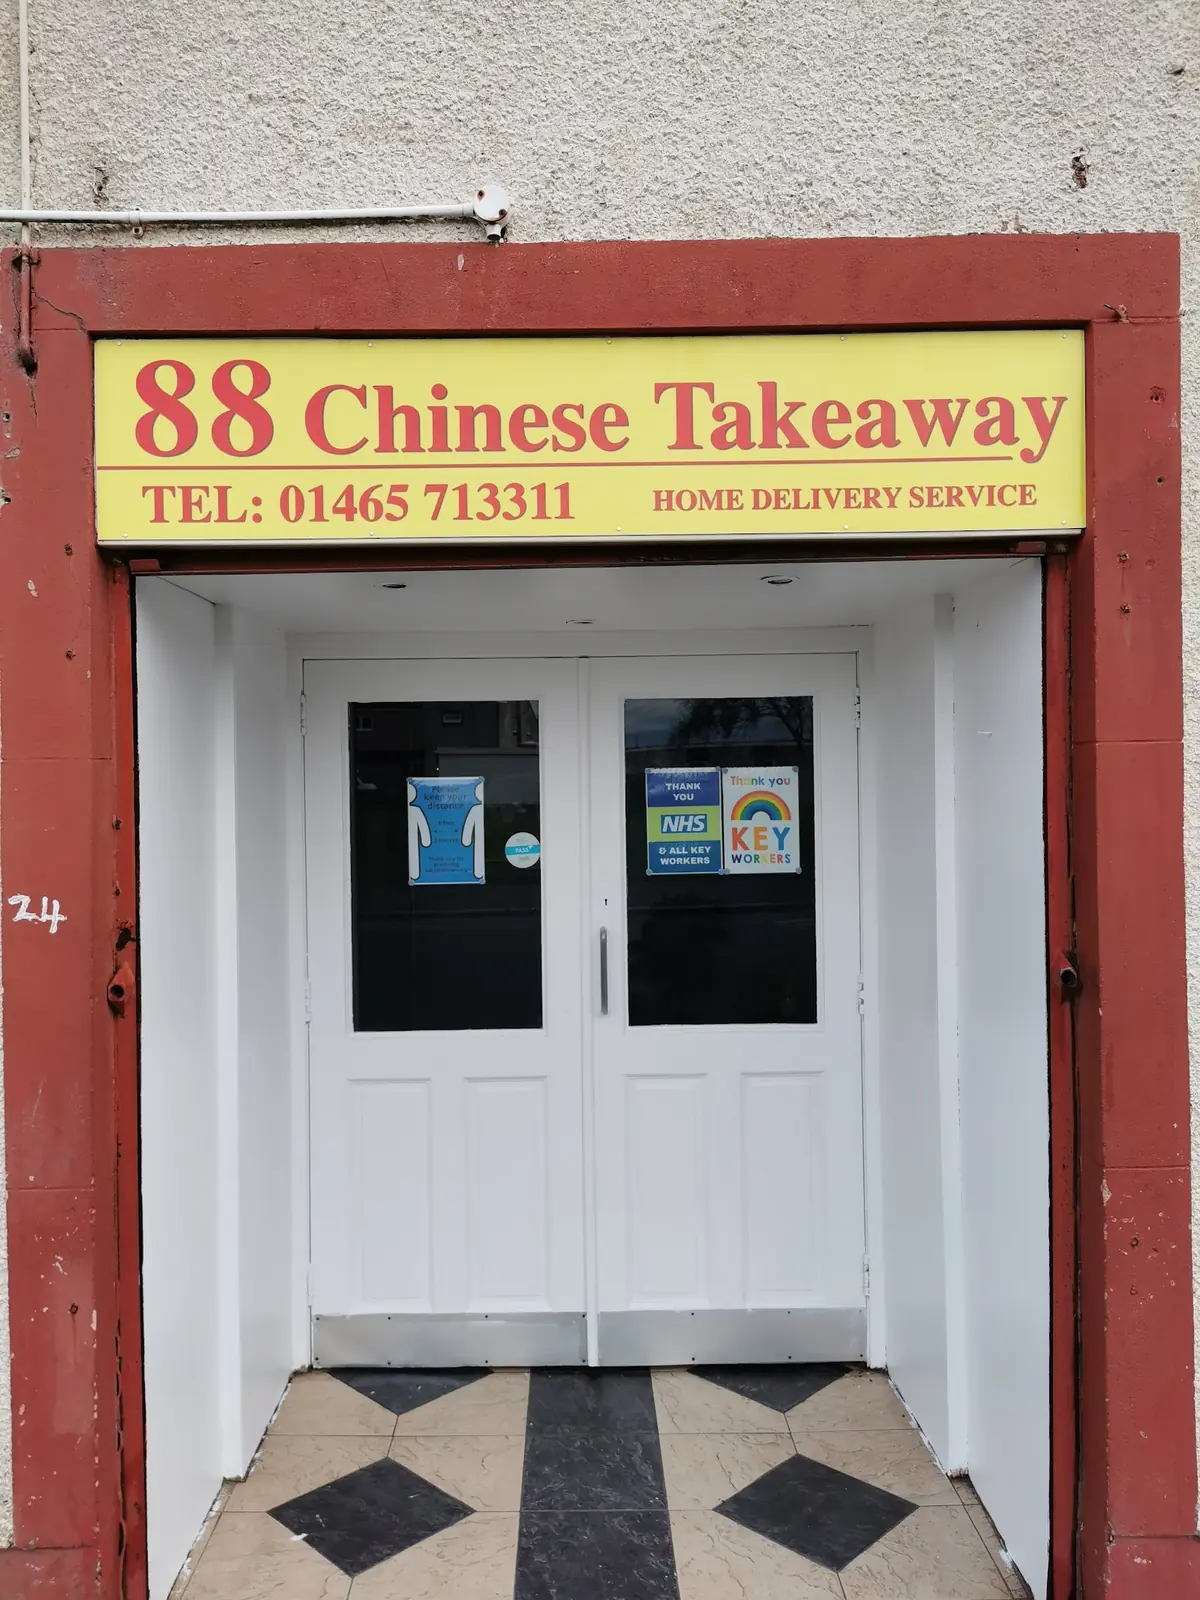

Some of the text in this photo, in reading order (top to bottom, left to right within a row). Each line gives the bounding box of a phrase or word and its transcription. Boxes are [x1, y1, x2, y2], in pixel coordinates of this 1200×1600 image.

[135, 359, 1068, 464] 88 Chinese Takeaway
[141, 482, 576, 523] TEL: 01465 713311
[652, 484, 1038, 512] HOME DELIVERY SERVICE
[665, 782, 701, 791] THANK
[730, 775, 791, 788] Thank you
[423, 793, 468, 802] keep your
[673, 793, 694, 801] YOU
[427, 802, 465, 810] distance
[662, 815, 706, 833] NHS
[731, 826, 791, 851] KEY
[690, 846, 712, 854] KEY
[660, 856, 710, 865] WORKERS
[731, 853, 791, 864] WORKERS
[8, 893, 68, 934] 24
